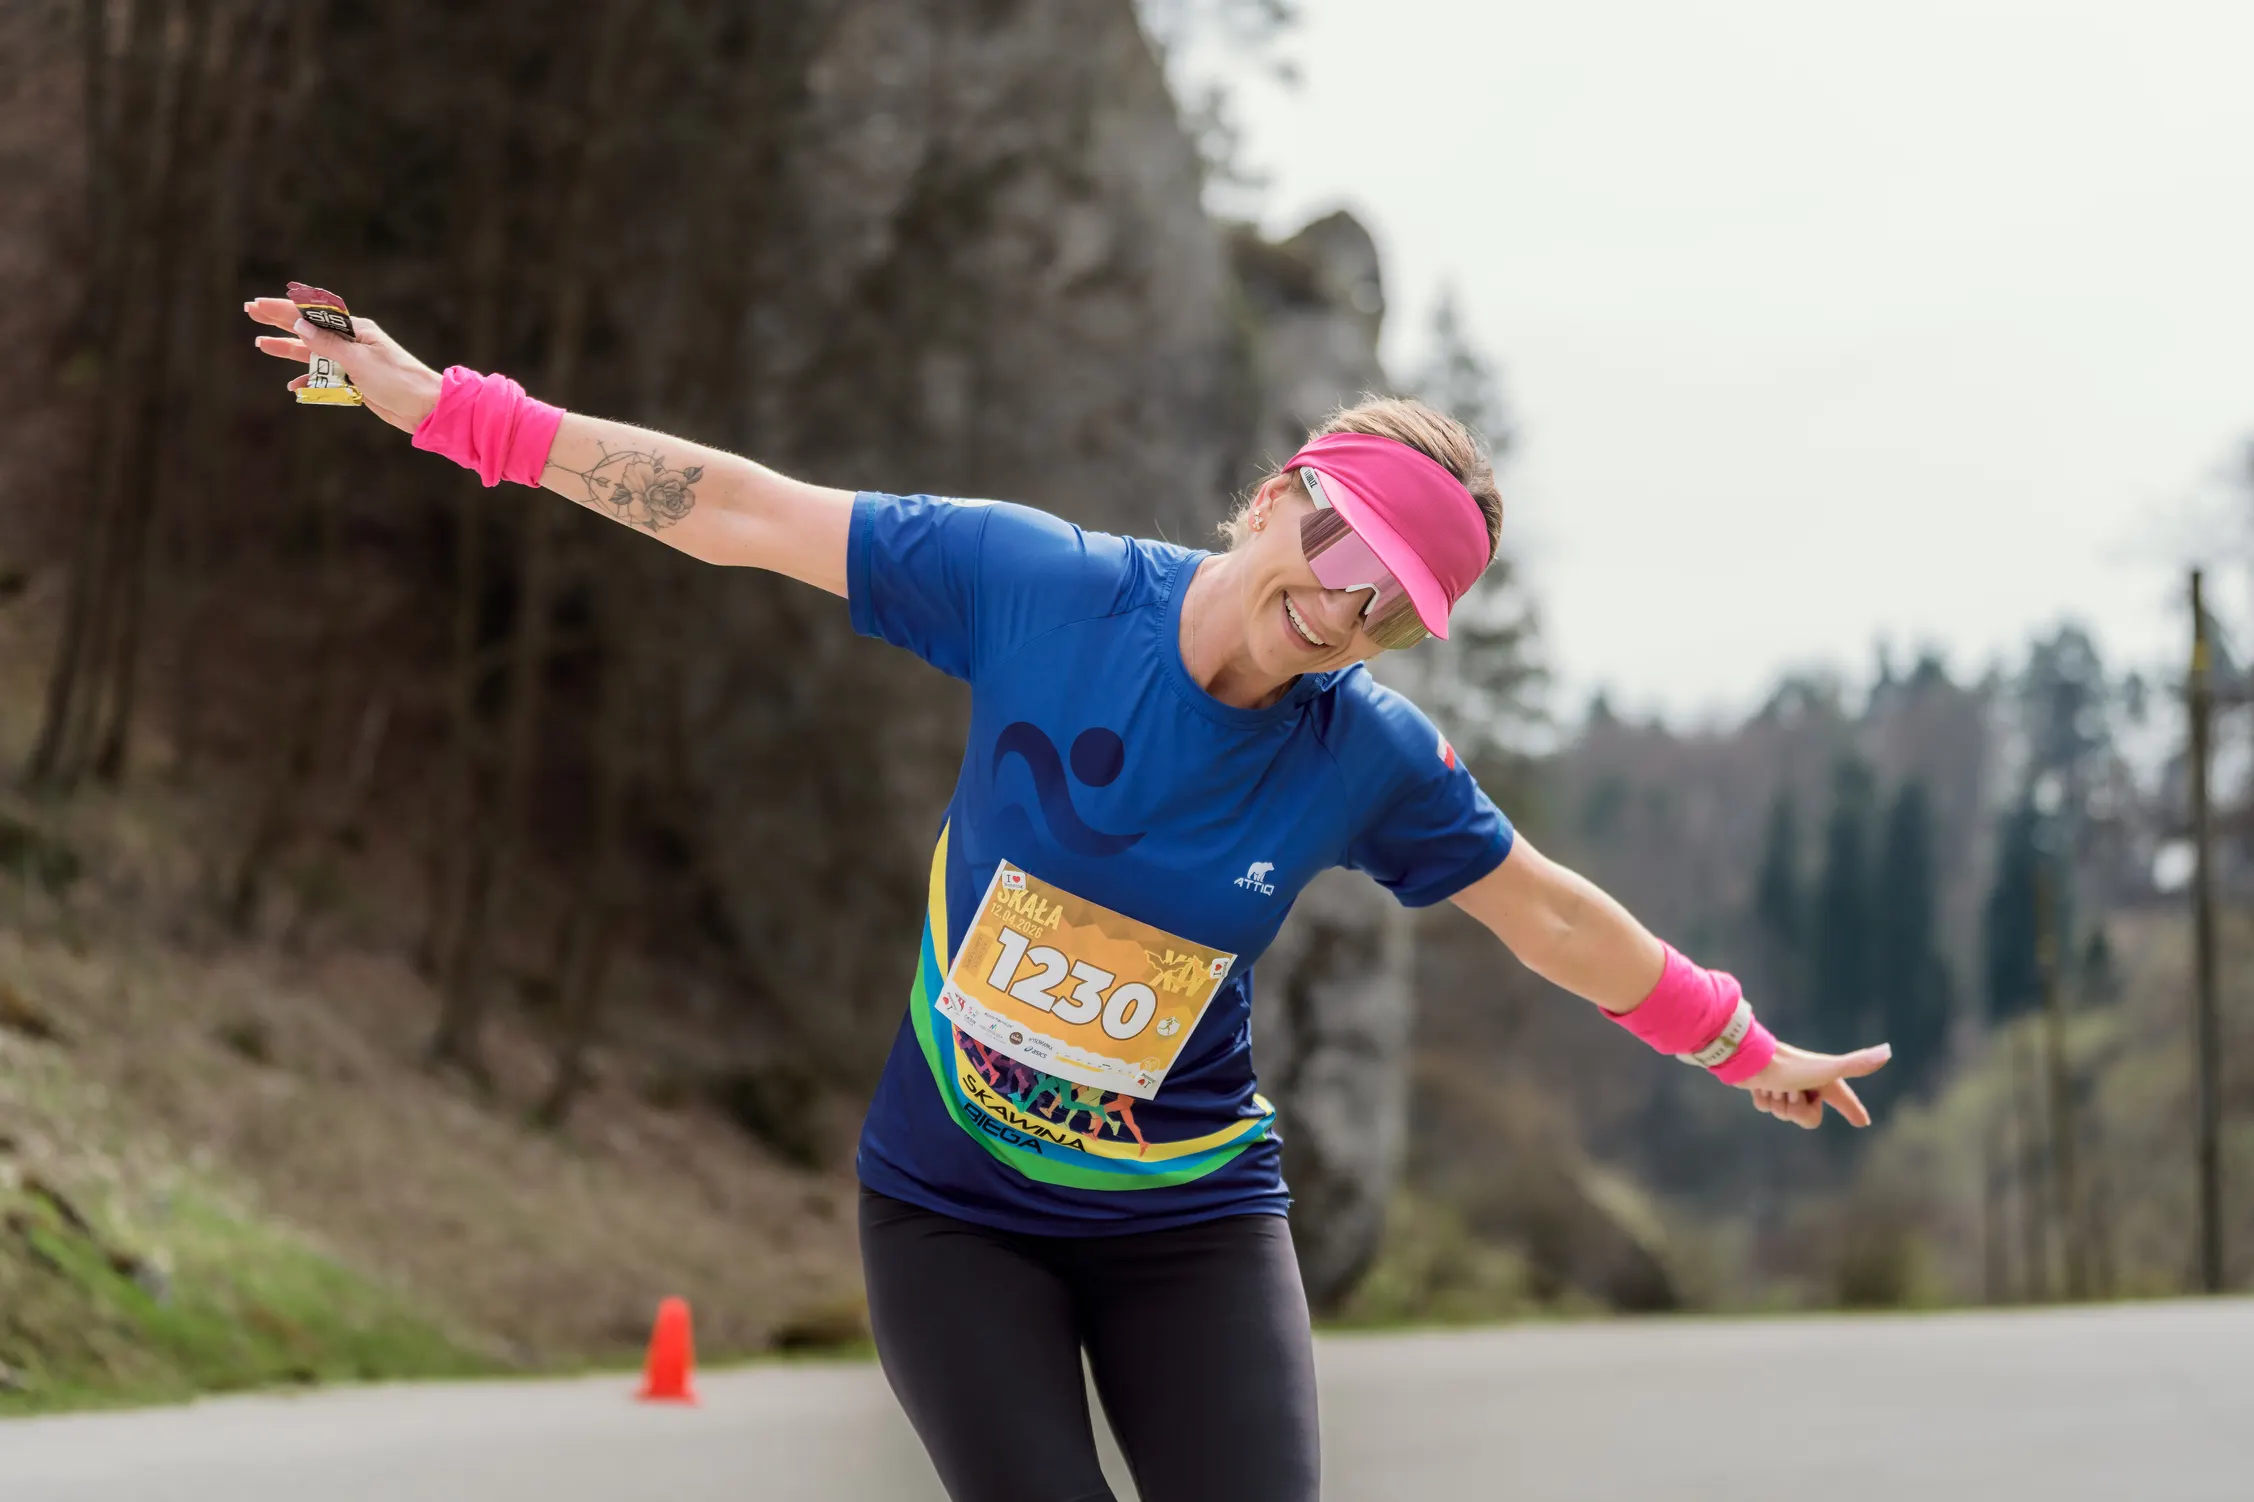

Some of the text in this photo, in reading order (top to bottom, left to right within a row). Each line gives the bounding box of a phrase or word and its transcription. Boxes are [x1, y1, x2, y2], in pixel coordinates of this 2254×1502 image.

[997, 887, 1064, 931] SKAŁA
[1233, 877, 1275, 897] ATTIQ
[990, 902, 1044, 939] 12.04.2026
[986, 925, 1159, 1041] 1230
[962, 1074, 1086, 1153] SKAWINA
[963, 1102, 1043, 1155] BIEGA
